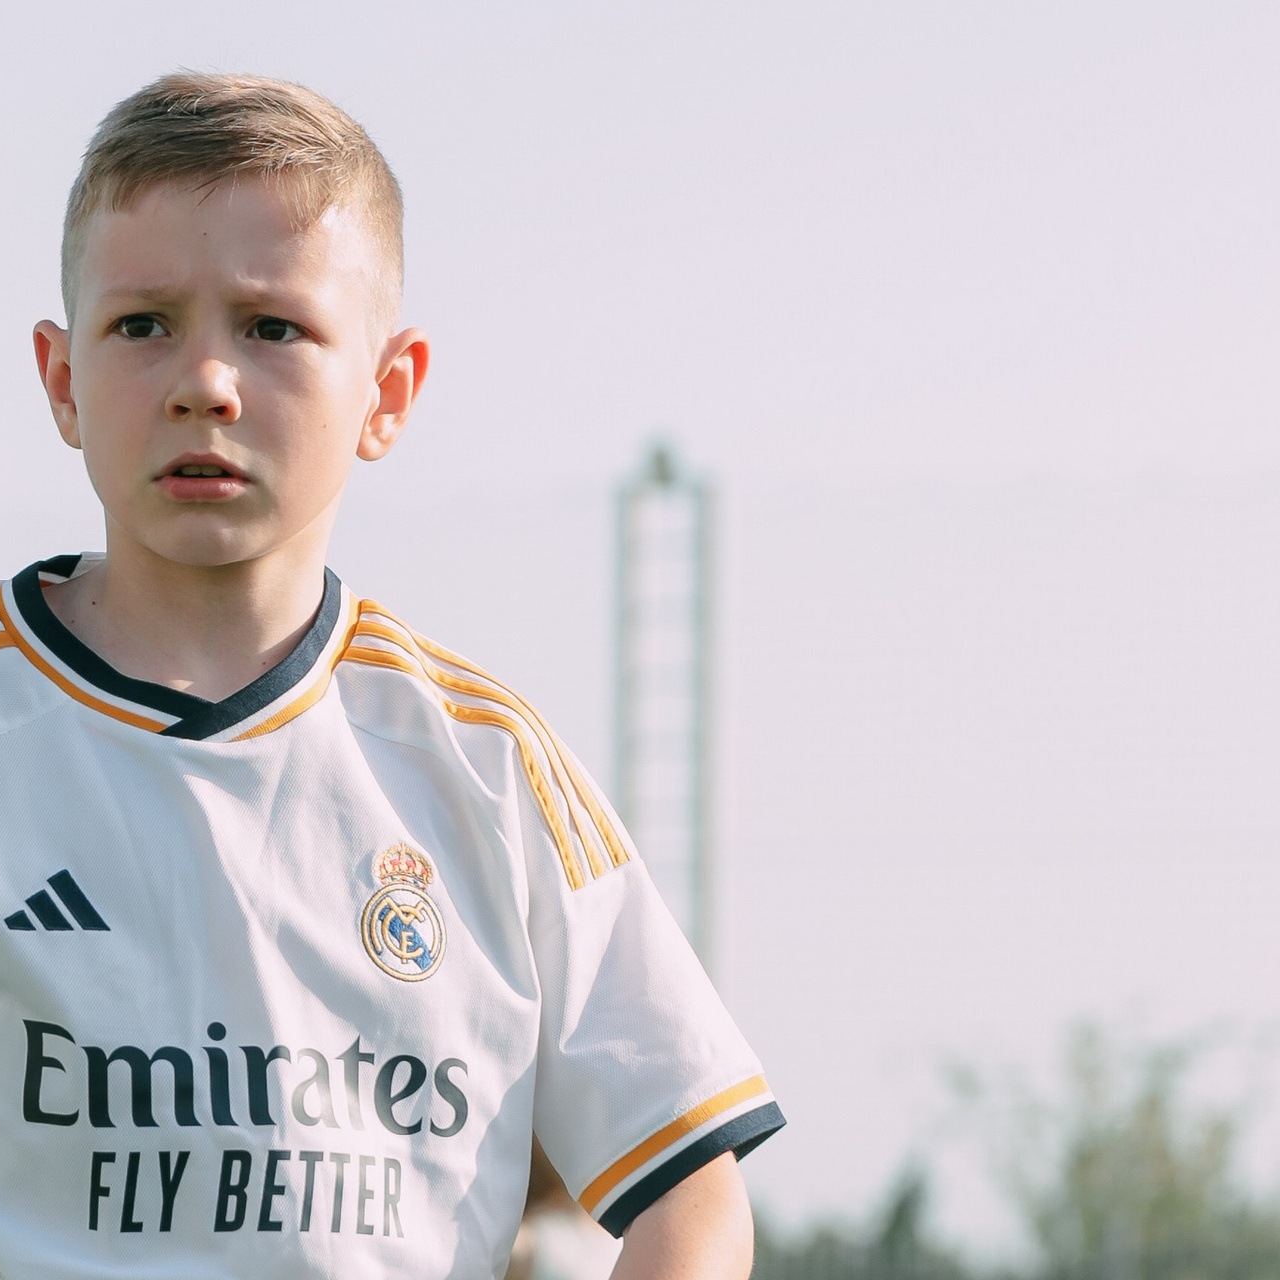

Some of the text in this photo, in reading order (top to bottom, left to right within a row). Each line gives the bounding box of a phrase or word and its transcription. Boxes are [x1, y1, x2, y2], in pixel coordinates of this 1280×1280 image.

[22, 1020, 468, 1137] Emirates
[88, 1150, 404, 1237] FLY BETTER
